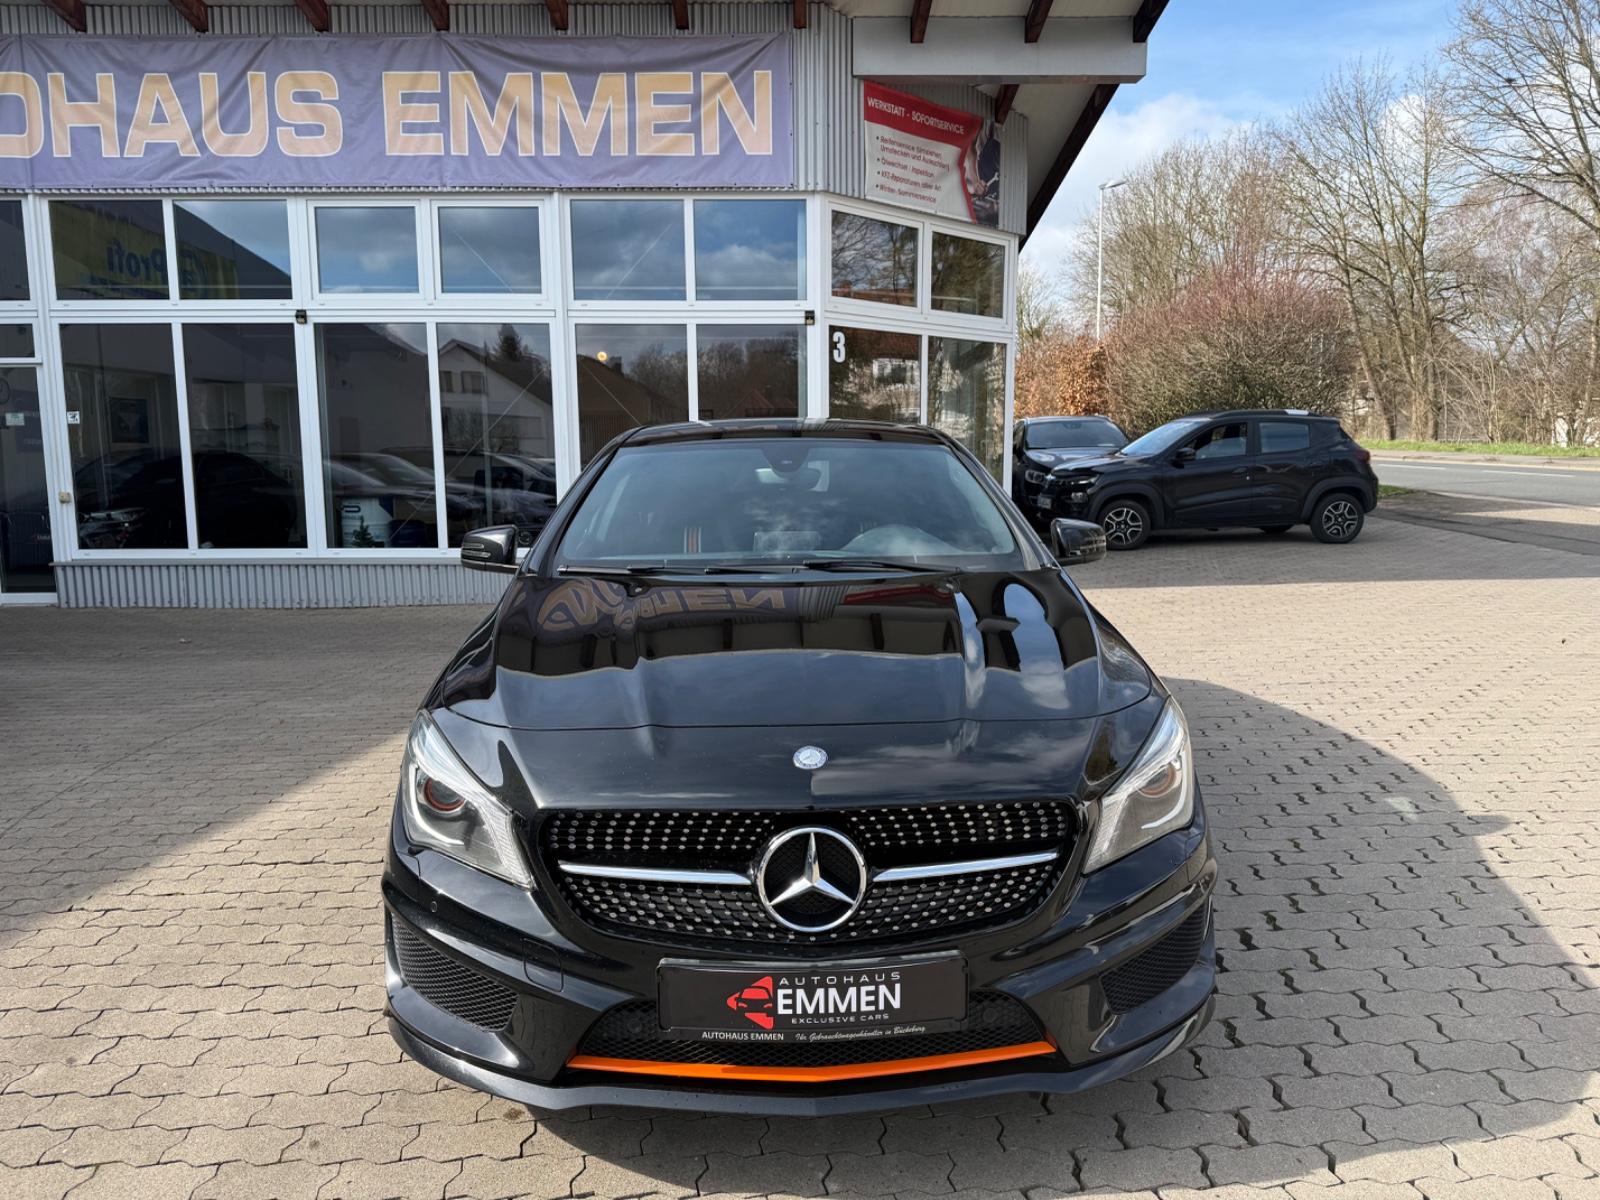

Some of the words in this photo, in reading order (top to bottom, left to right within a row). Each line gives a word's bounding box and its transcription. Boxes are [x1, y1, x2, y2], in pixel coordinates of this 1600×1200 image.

[382, 70, 773, 156] EMMEN
[867, 96, 905, 117] WERKSTATT
[911, 111, 965, 134] SOFORTSERVICE
[832, 331, 846, 363] 3
[779, 971, 901, 986] AUTOHAUS
[777, 983, 901, 1015] EMMEN
[791, 1015, 856, 1025] EXCLUSIVE
[860, 1012, 890, 1021] CARS
[701, 1031, 750, 1041] AUTOHAUS
[750, 1033, 785, 1041] EMMEN
